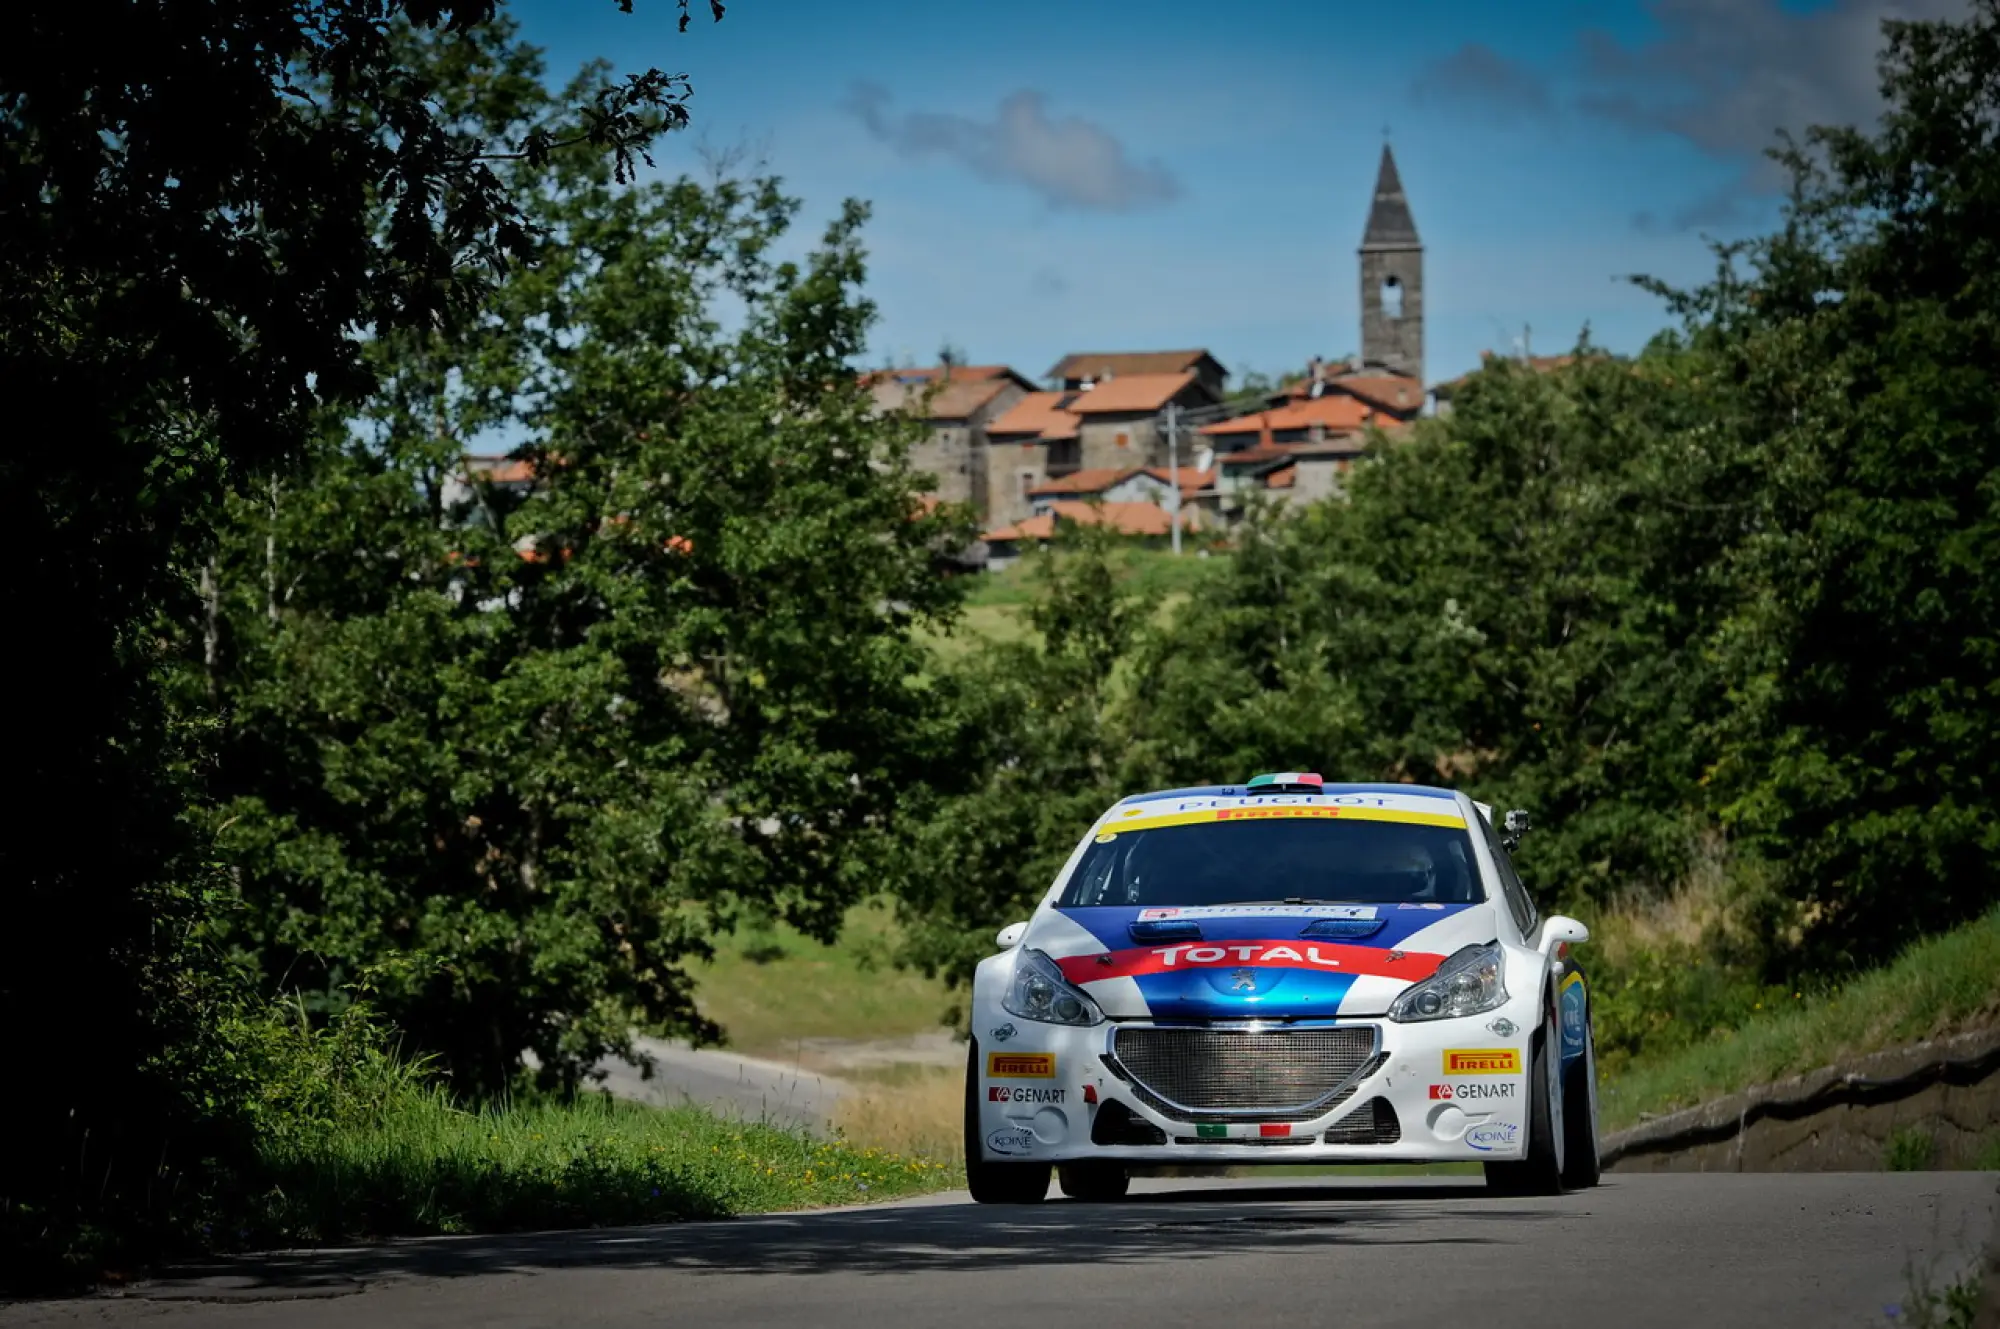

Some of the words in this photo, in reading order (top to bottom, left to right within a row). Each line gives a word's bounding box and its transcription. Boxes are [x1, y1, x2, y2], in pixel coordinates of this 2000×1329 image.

[1151, 944, 1341, 967] TOTAL
[993, 1056, 1049, 1074] PIRELLI
[1449, 1052, 1514, 1071] PIRELLI
[1013, 1088, 1066, 1104] GENART
[1456, 1083, 1516, 1099] GENART
